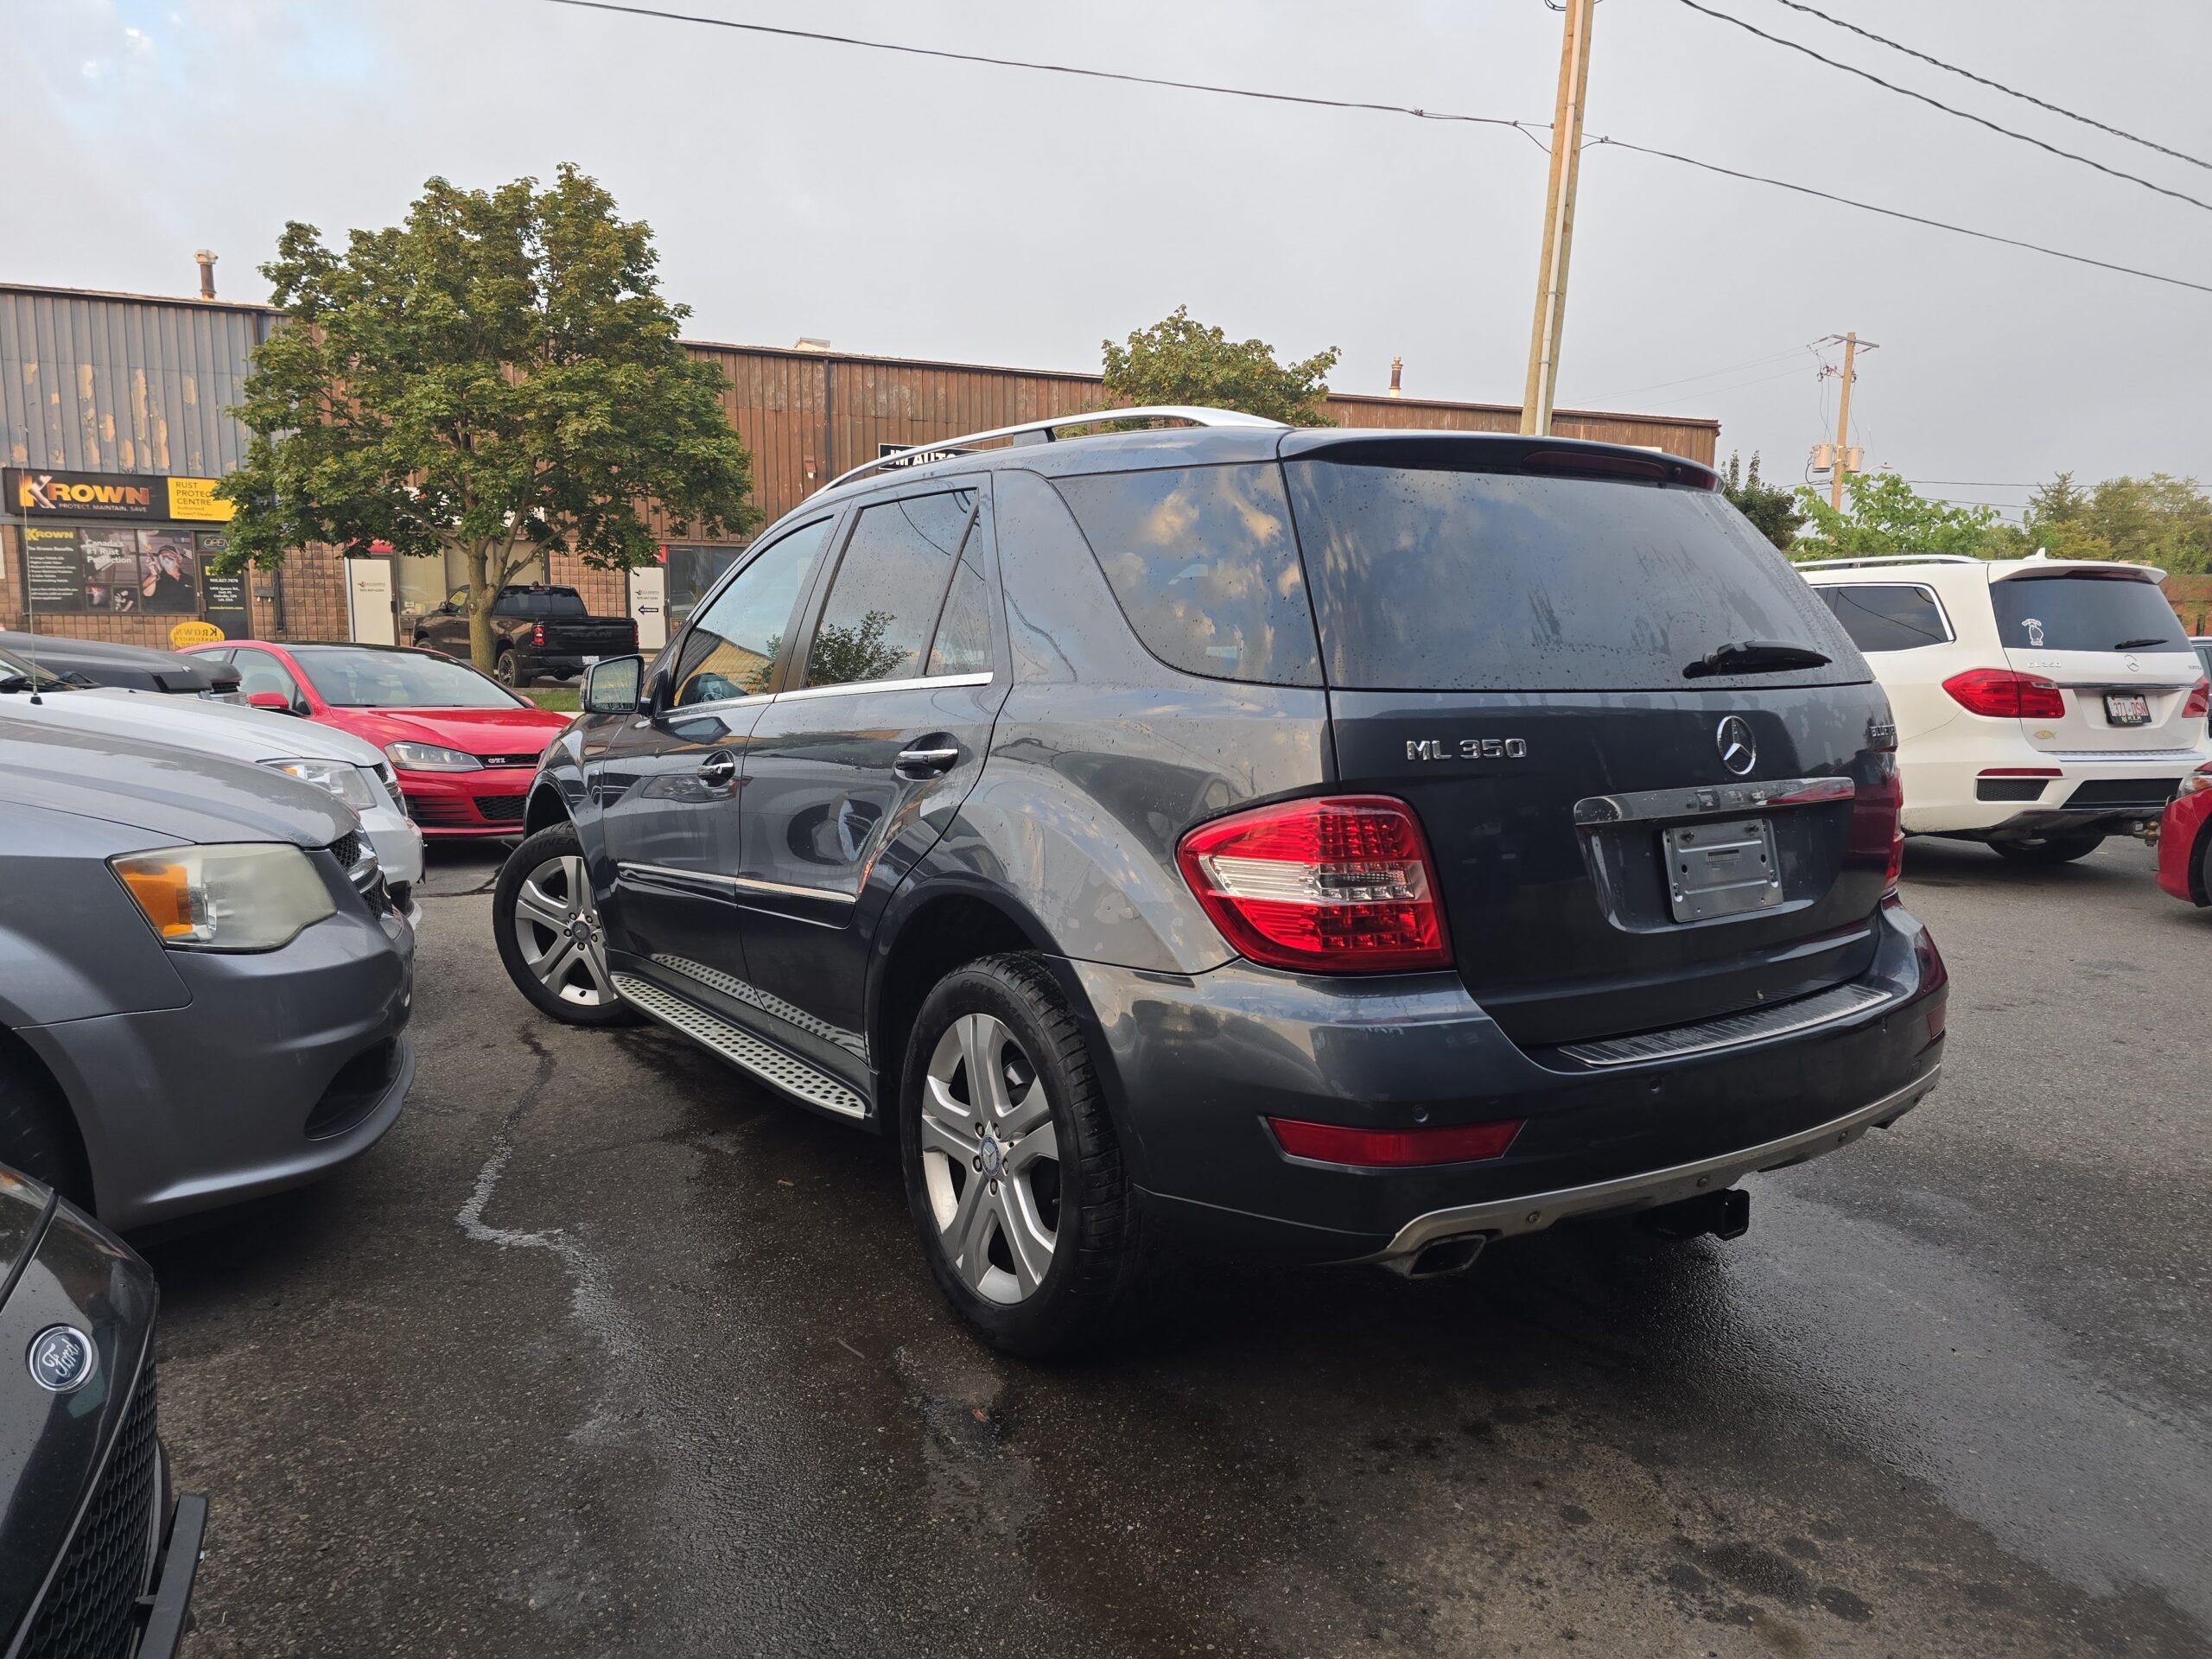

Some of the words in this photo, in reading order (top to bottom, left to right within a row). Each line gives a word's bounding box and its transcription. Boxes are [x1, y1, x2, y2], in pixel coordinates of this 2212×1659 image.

[19, 474, 150, 509] KROWN
[177, 498, 212, 506] CENTRE
[25, 528, 74, 541] KROWN
[204, 537, 230, 547] OPEN
[1406, 740, 1452, 761] ML
[1459, 738, 1528, 759] 350
[41, 1338, 81, 1377] Ford
